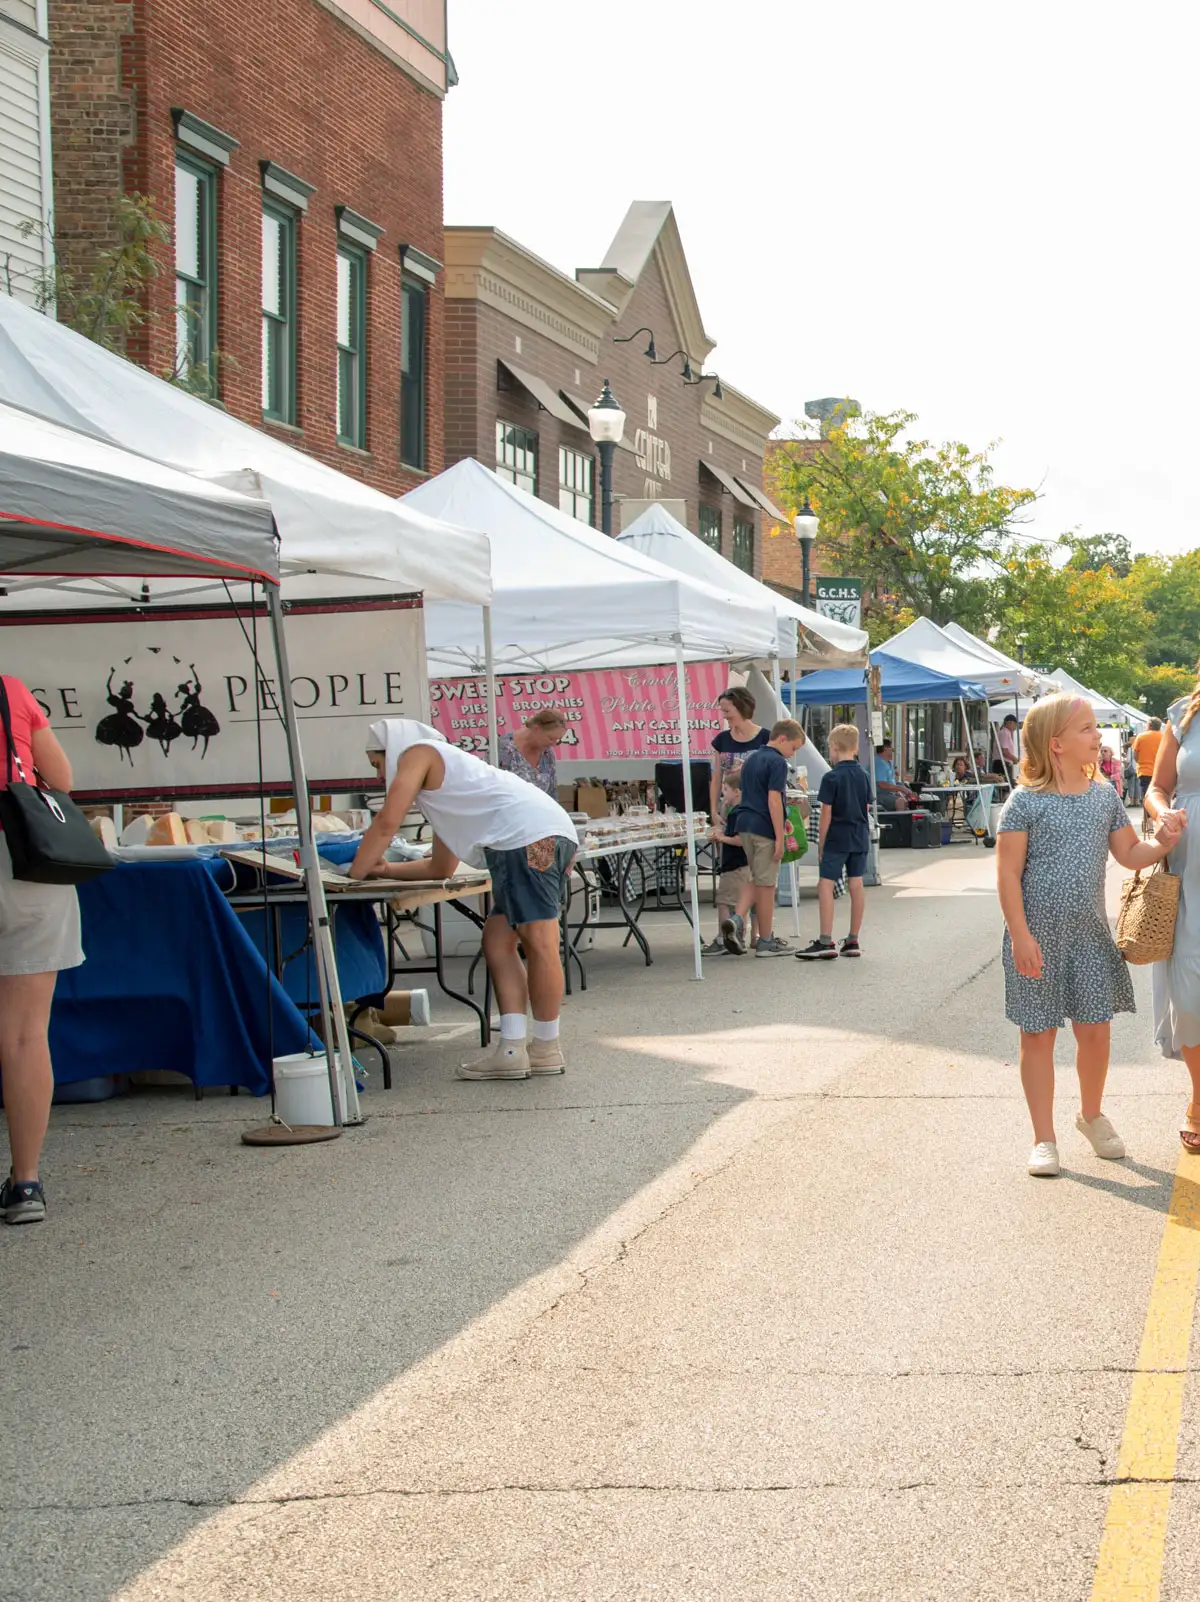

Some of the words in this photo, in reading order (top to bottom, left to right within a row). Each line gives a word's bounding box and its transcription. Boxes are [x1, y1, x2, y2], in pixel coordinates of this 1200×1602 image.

[818, 587, 860, 598] G.C.H.S.
[223, 671, 404, 713] PEOPLE
[509, 677, 570, 696] STOP
[461, 702, 488, 716] PIES
[512, 697, 584, 712] BROWNIES
[451, 715, 506, 729] BREAS
[612, 720, 645, 732] ANY
